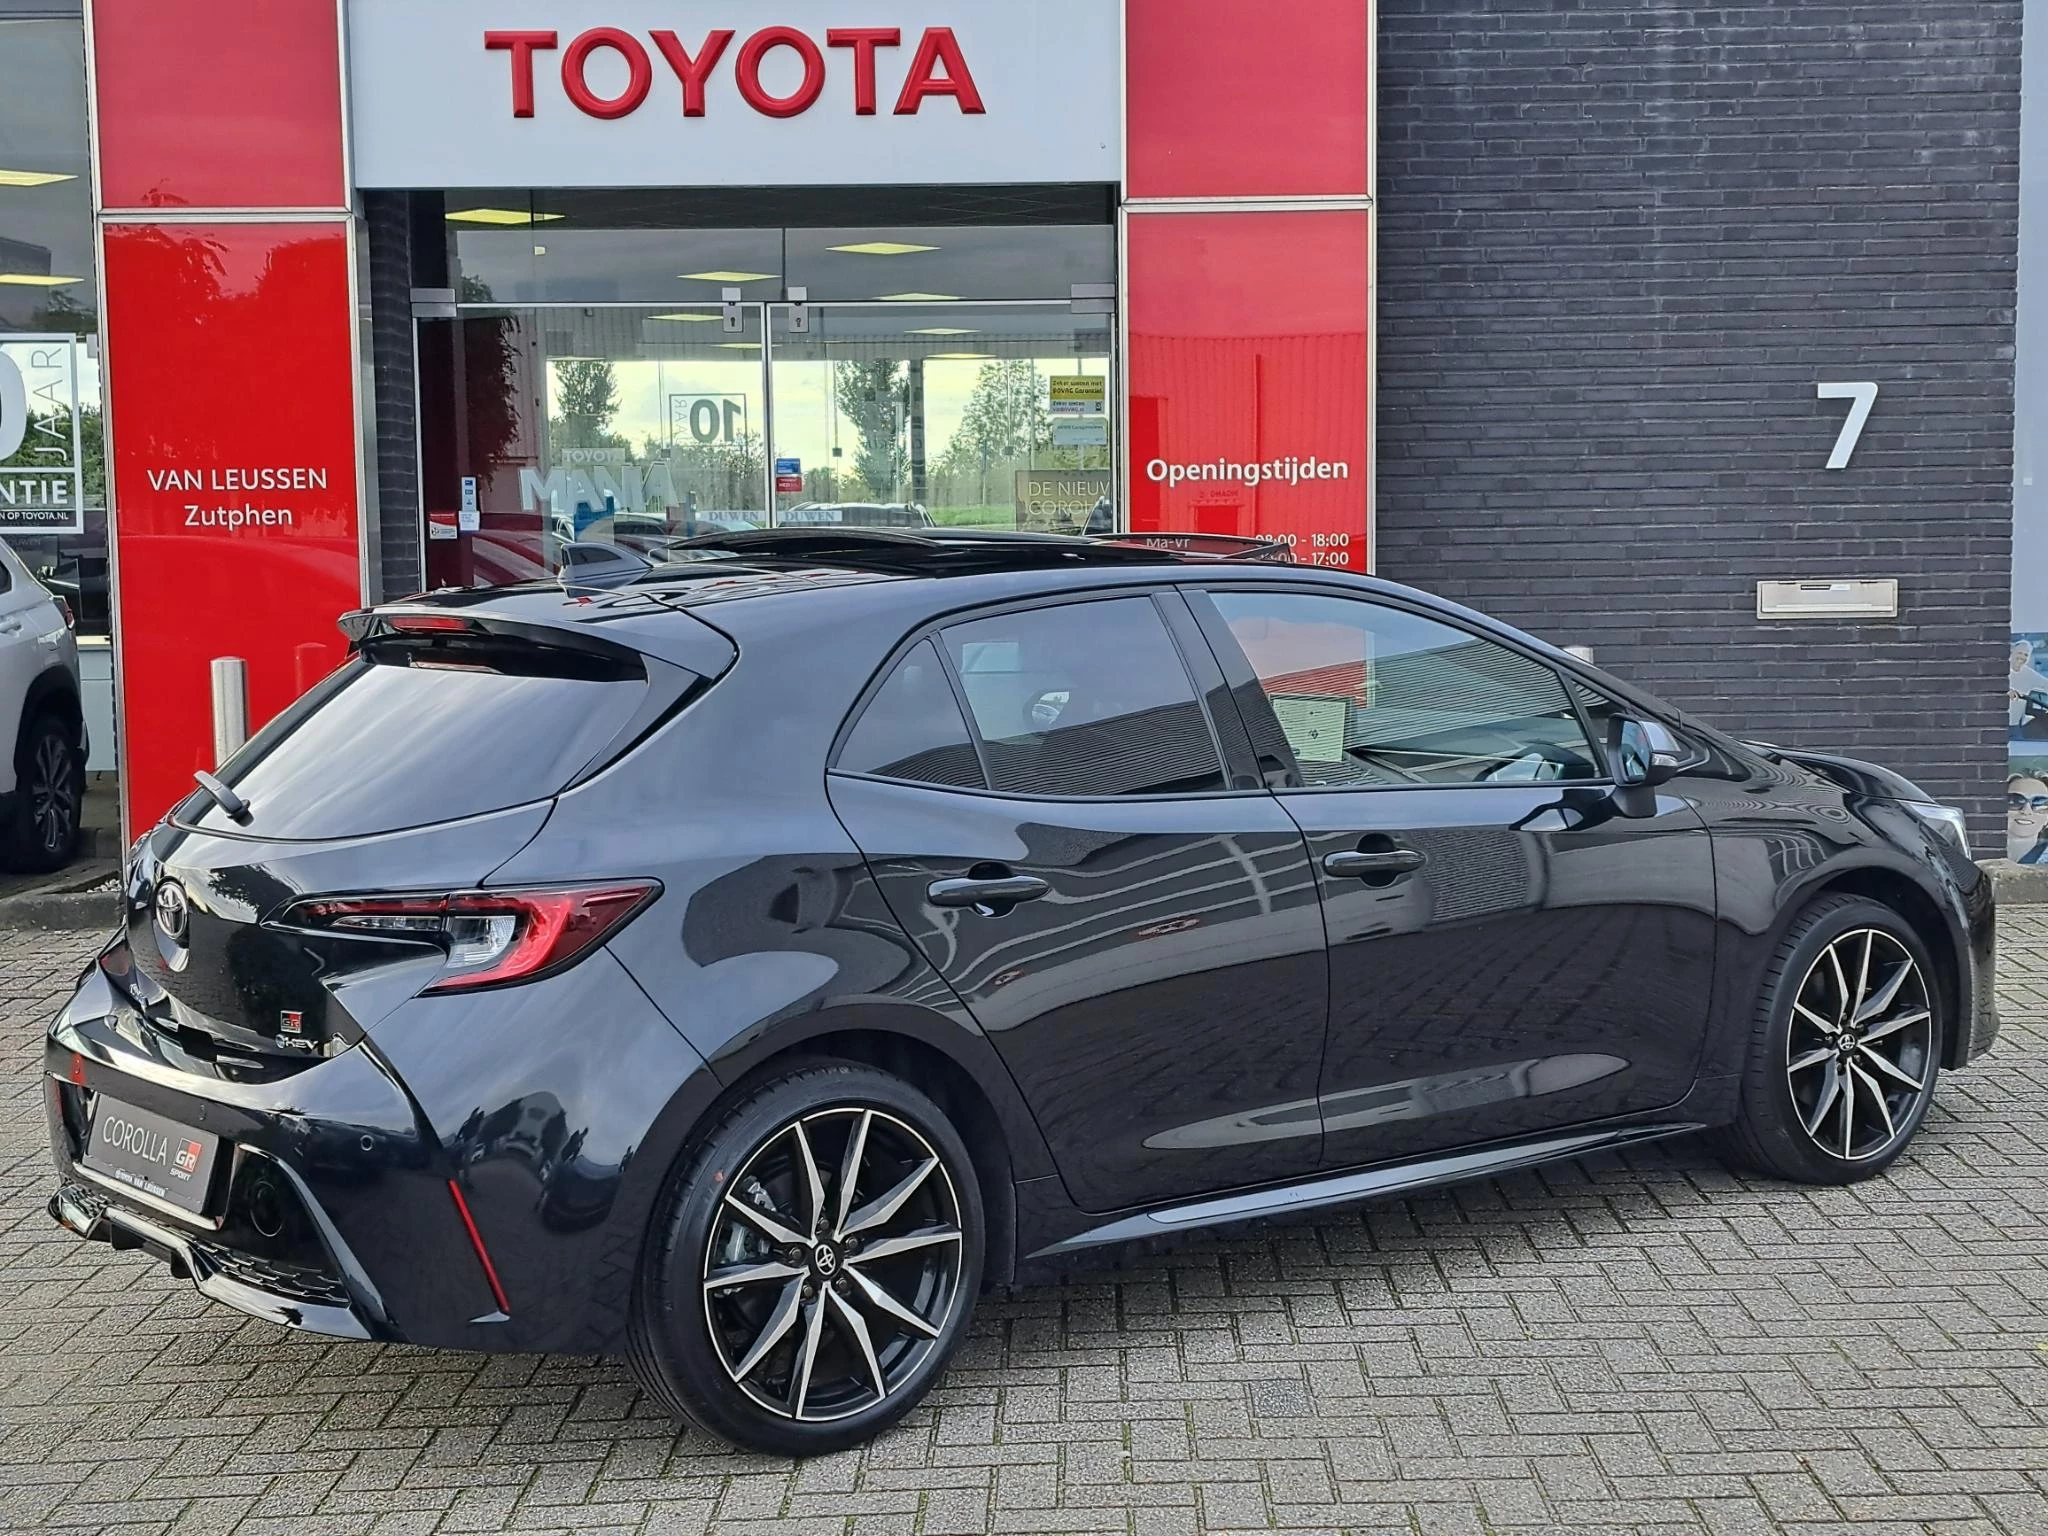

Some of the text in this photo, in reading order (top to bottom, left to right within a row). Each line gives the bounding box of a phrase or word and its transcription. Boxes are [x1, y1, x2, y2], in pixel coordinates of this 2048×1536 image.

[484, 25, 986, 120] TOYOTA
[31, 348, 67, 461] JAAR
[1817, 382, 1878, 470] 7
[147, 468, 327, 490] VAN LEUSSEN
[1146, 456, 1348, 487] Openingstijden
[1028, 482, 1052, 496] DE
[7, 512, 20, 520] OP
[22, 512, 69, 520] TOYOTA.NL
[184, 503, 292, 531] Zutphen
[709, 511, 759, 521] DUWEN
[785, 511, 835, 521] DUWEN
[1311, 533, 1349, 547] 18:00
[1311, 551, 1349, 566] 17:00
[103, 1116, 168, 1166] COROLLA
[175, 1150, 196, 1169] GR
[169, 1167, 192, 1182] SPORT
